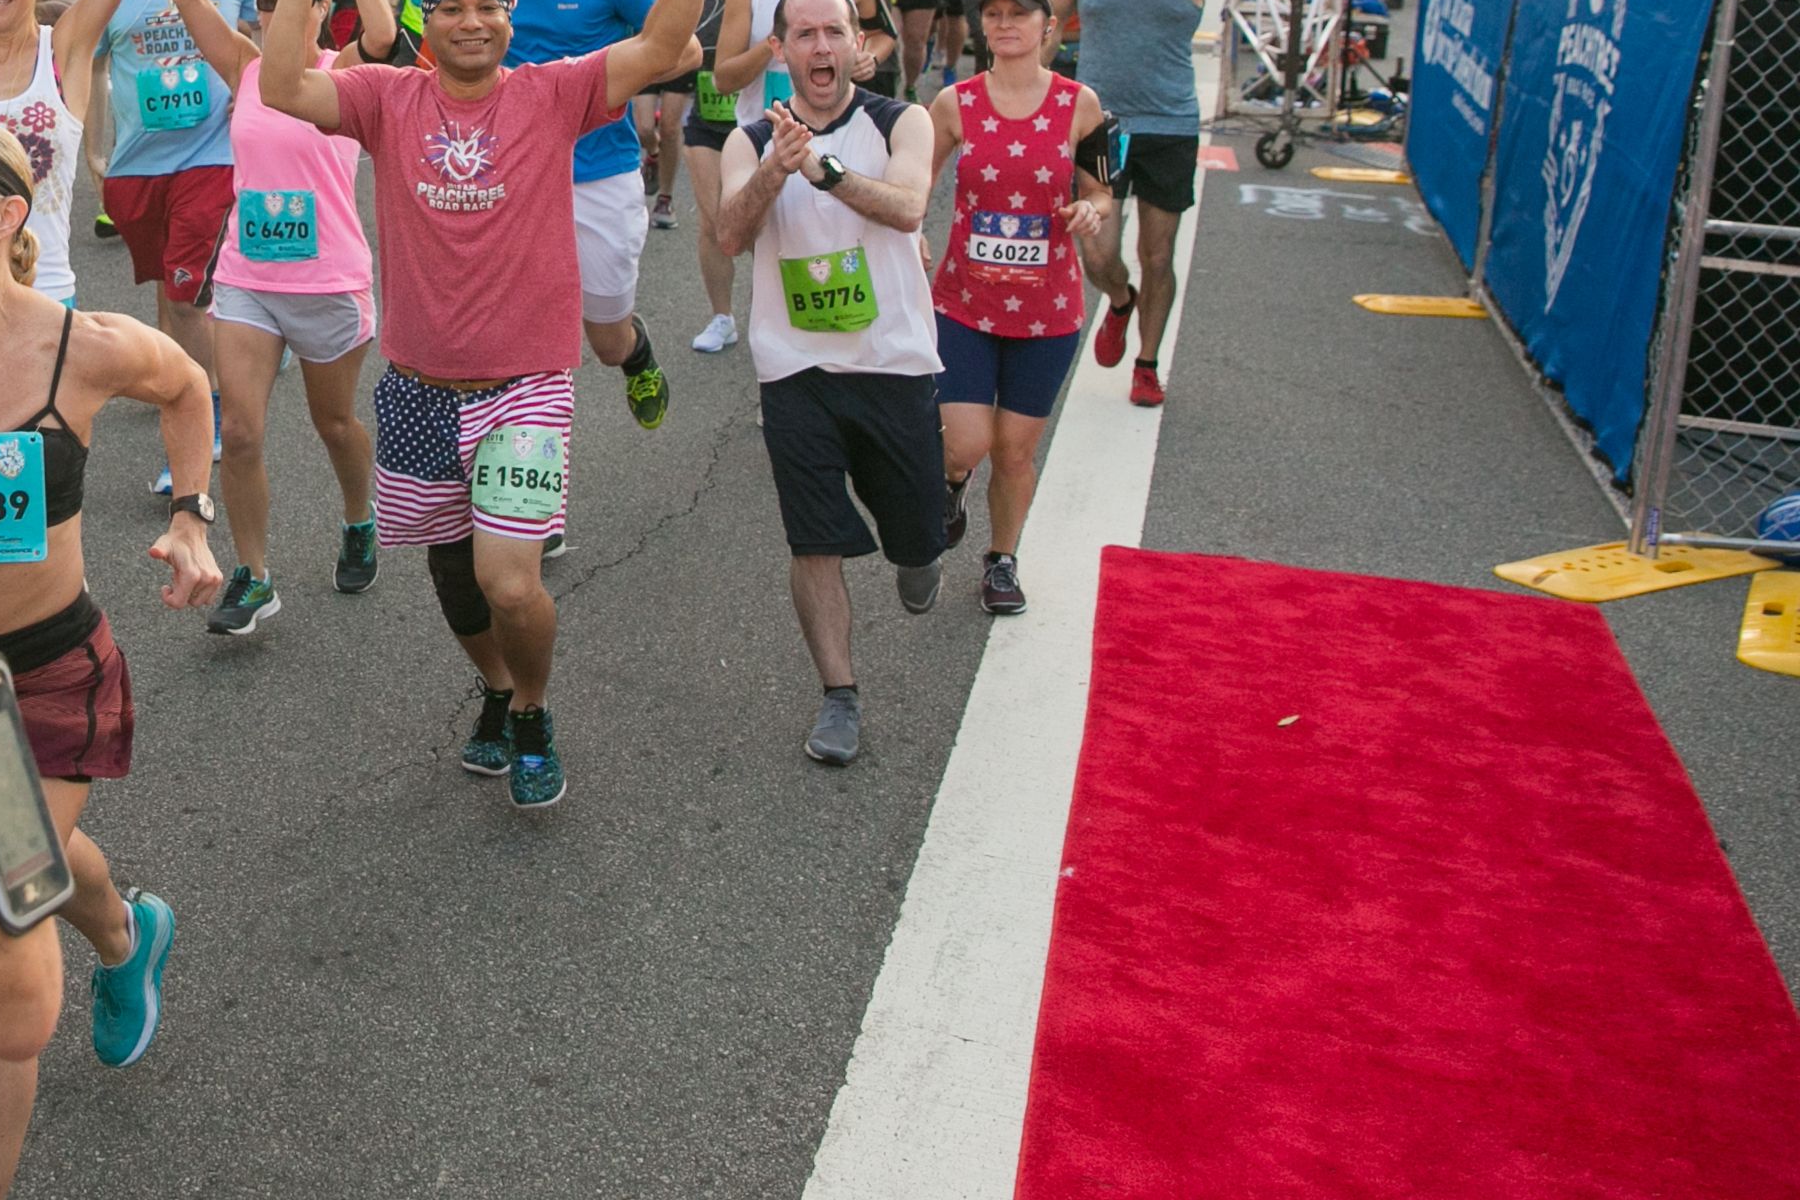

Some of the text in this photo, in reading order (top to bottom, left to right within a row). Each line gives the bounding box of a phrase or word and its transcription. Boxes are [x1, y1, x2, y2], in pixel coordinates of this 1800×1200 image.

[145, 41, 179, 55] ROAD
[146, 90, 203, 112] C 7910
[416, 181, 506, 202] PEACHTREE
[429, 199, 494, 211] ROAD RACE
[246, 220, 309, 239] C 6470
[976, 242, 1041, 262] C 6022
[792, 284, 866, 312] B 5776
[476, 465, 562, 493] E 15843
